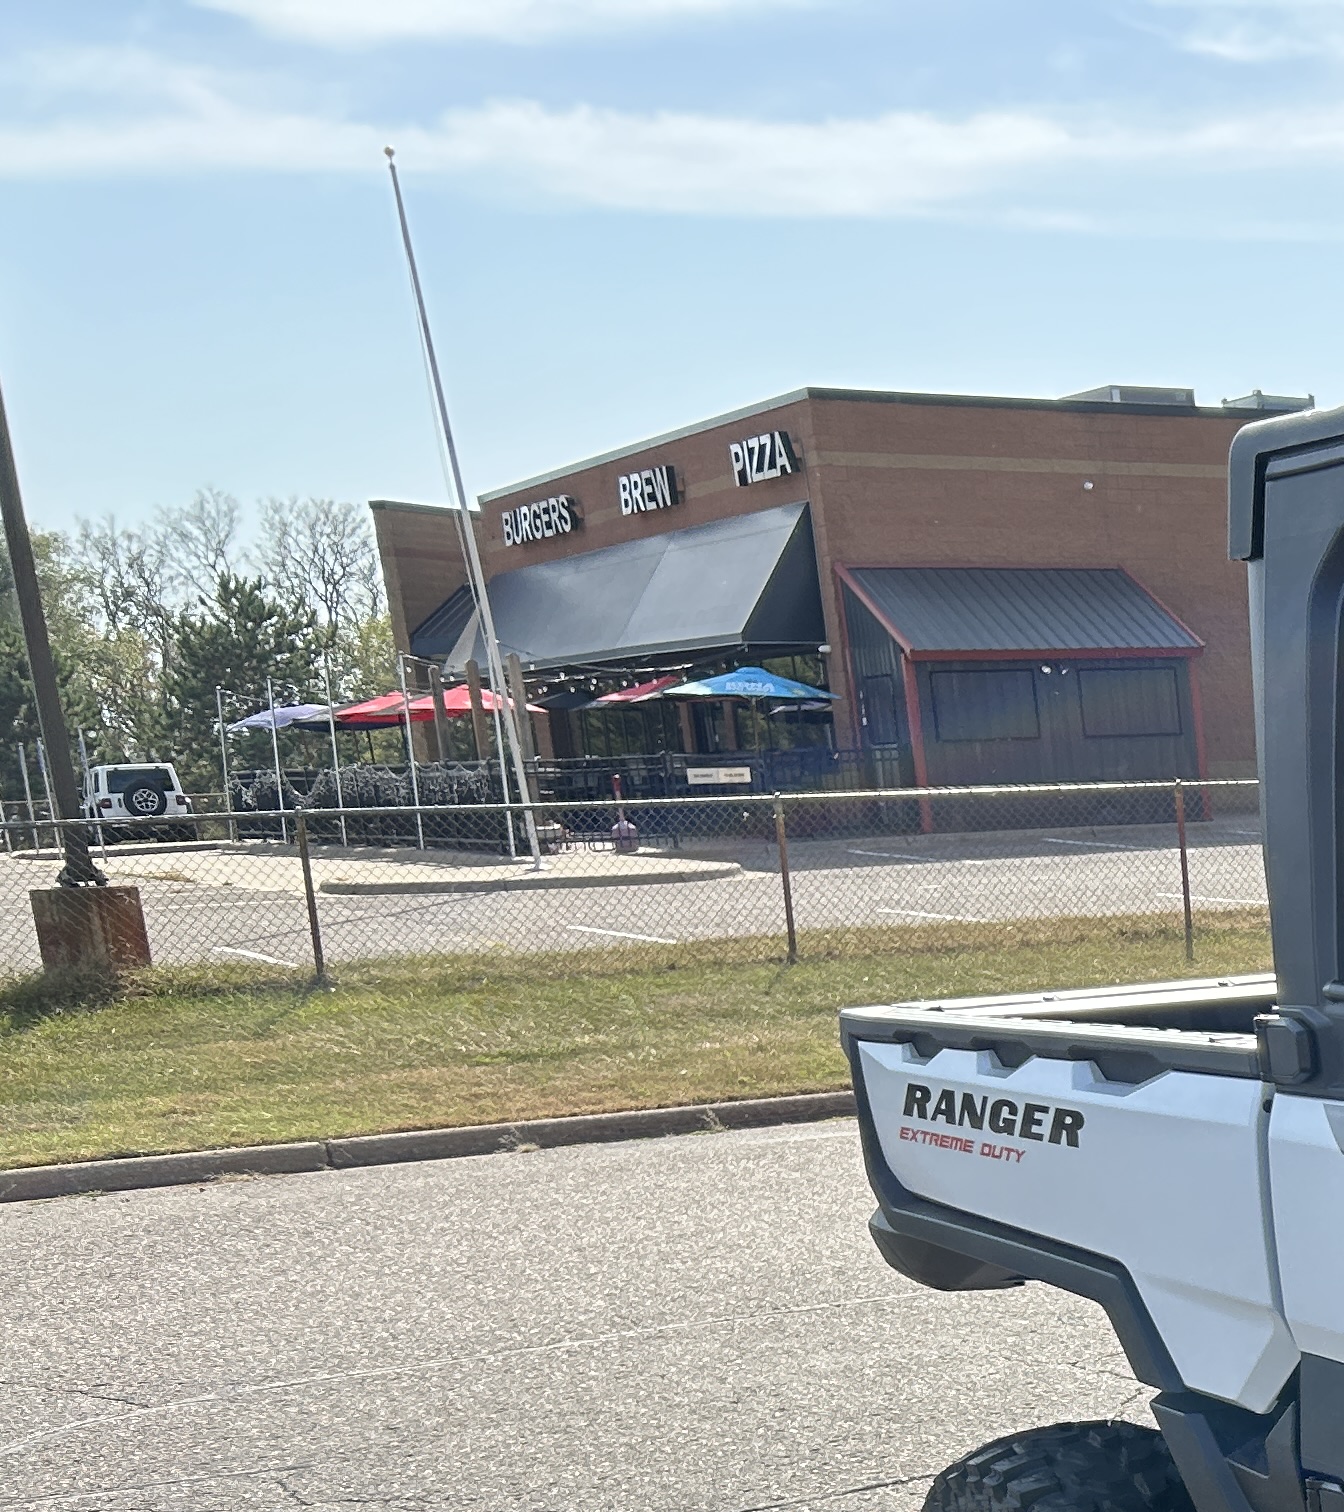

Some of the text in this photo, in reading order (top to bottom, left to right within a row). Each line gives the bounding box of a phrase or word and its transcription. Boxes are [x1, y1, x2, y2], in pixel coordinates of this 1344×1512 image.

[501, 431, 792, 547] BURGERS BREW PIZZA
[900, 1126, 1026, 1164] EXTREME DUTY
[903, 1082, 1085, 1149] RANGER
